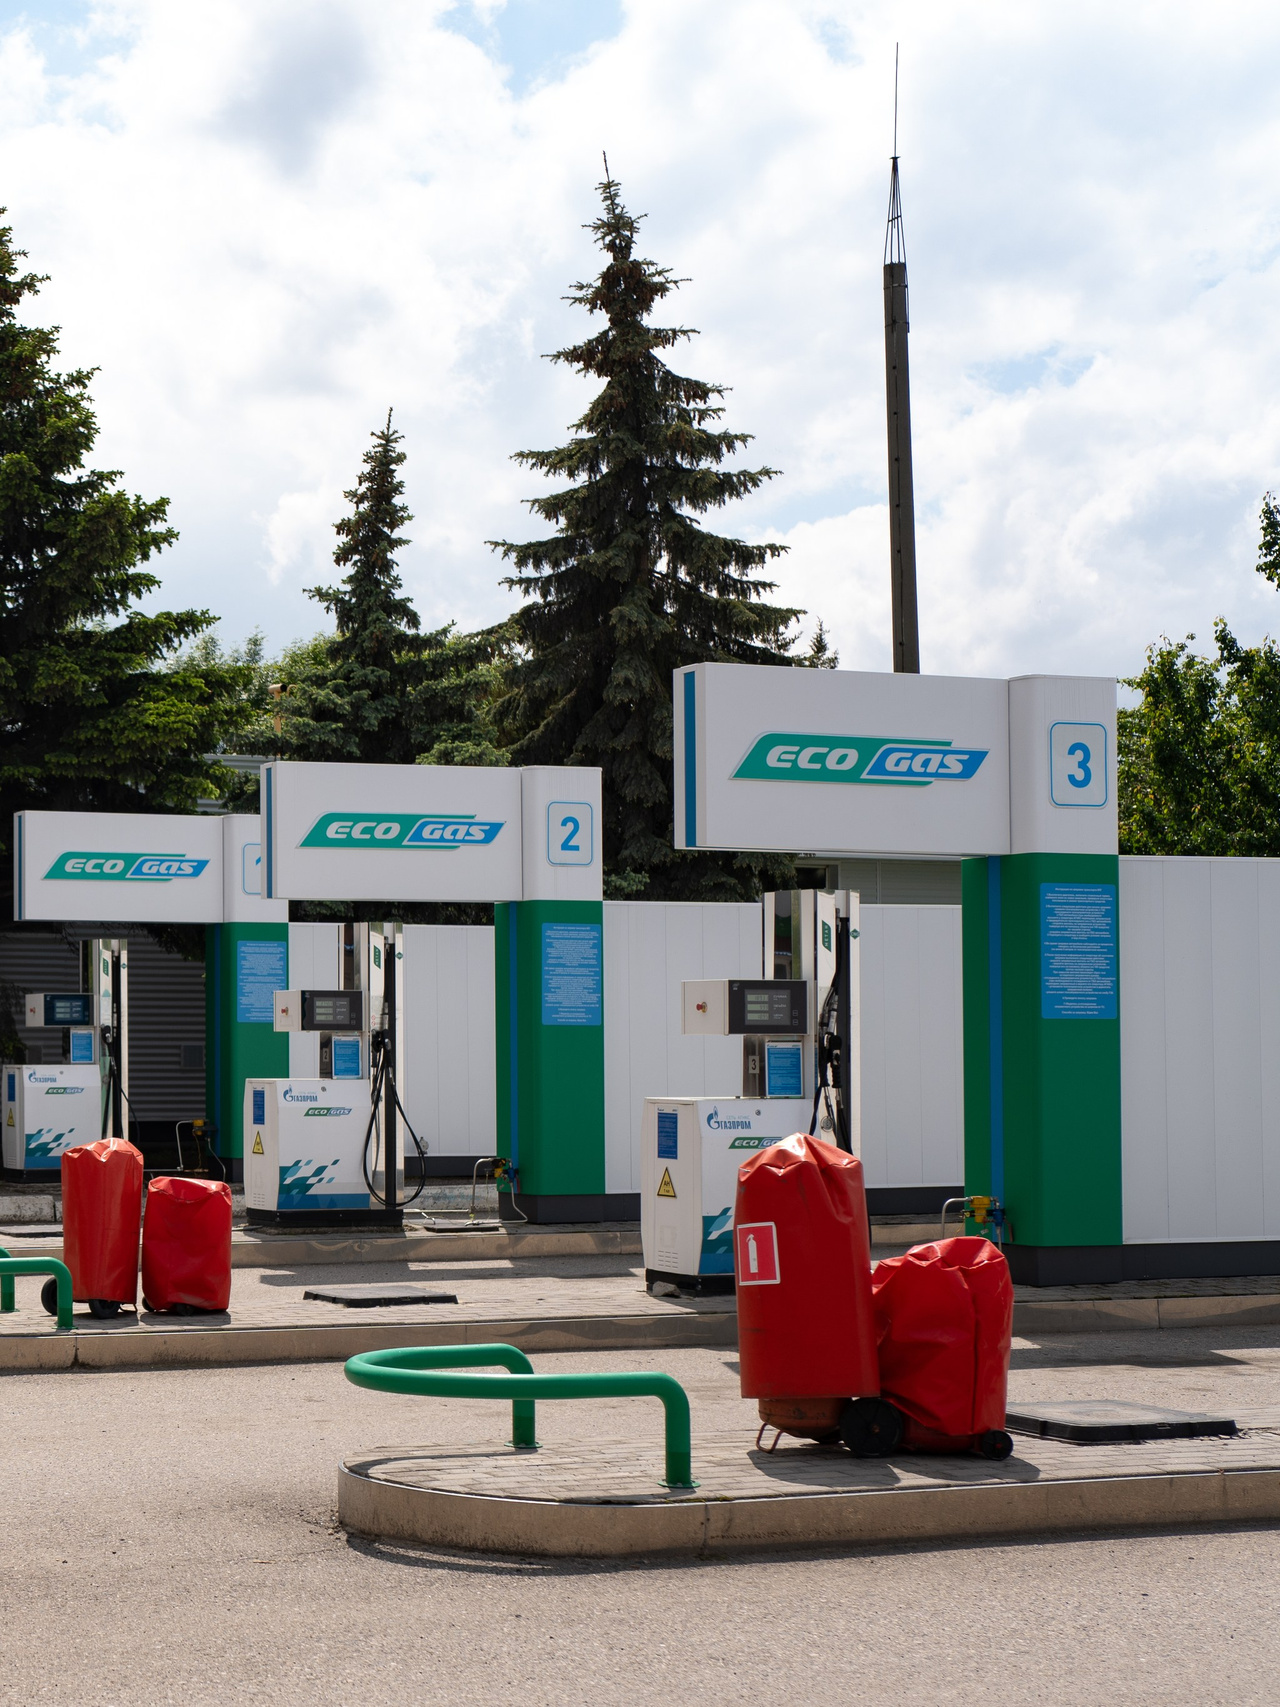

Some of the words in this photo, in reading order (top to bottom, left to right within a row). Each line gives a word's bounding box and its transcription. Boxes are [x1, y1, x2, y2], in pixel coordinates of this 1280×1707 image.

[766, 745, 859, 771] ECO
[1067, 741, 1092, 788] 3
[325, 821, 401, 839] ECO
[560, 815, 580, 852] 2
[64, 858, 125, 874] ECO
[751, 1058, 757, 1071] 3
[720, 1121, 752, 1130] ГАЗПРОМ
